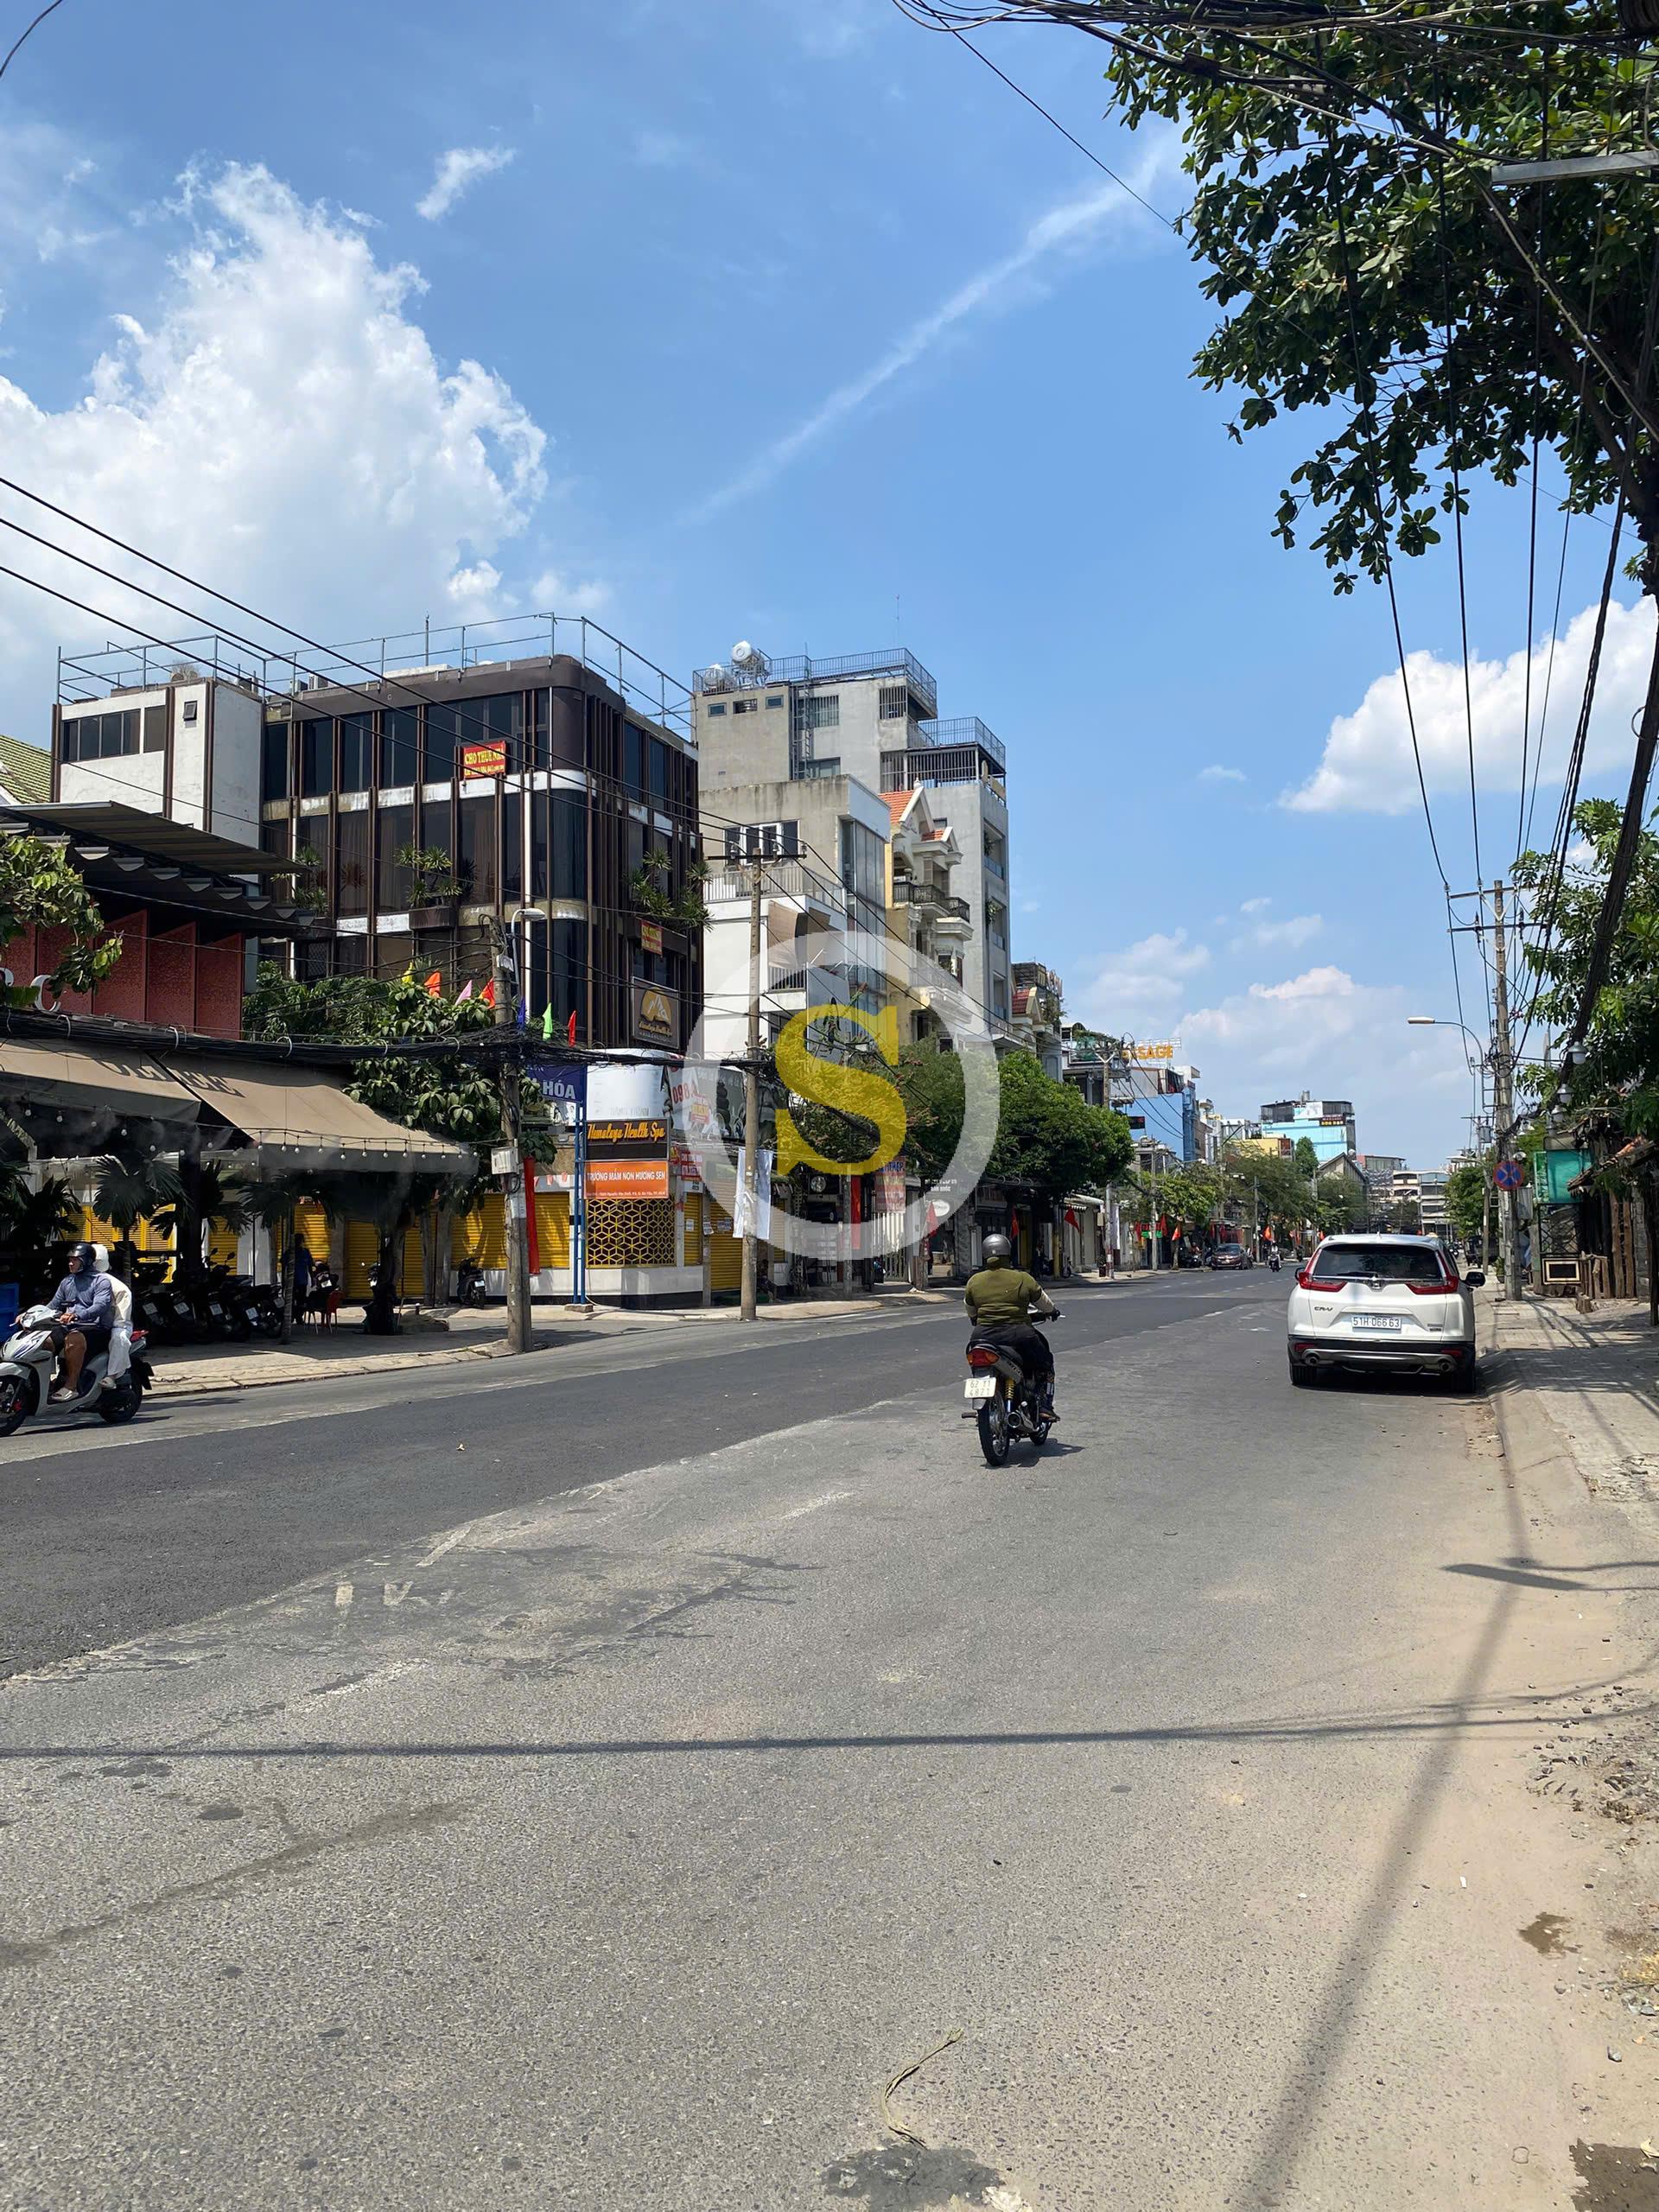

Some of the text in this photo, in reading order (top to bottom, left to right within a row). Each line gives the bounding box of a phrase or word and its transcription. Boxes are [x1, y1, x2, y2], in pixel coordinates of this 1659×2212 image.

[465, 753, 477, 765] CHO
[542, 1079, 576, 1100] HÓA
[650, 1122, 665, 1141] Spa
[655, 1171, 666, 1180] SEN
